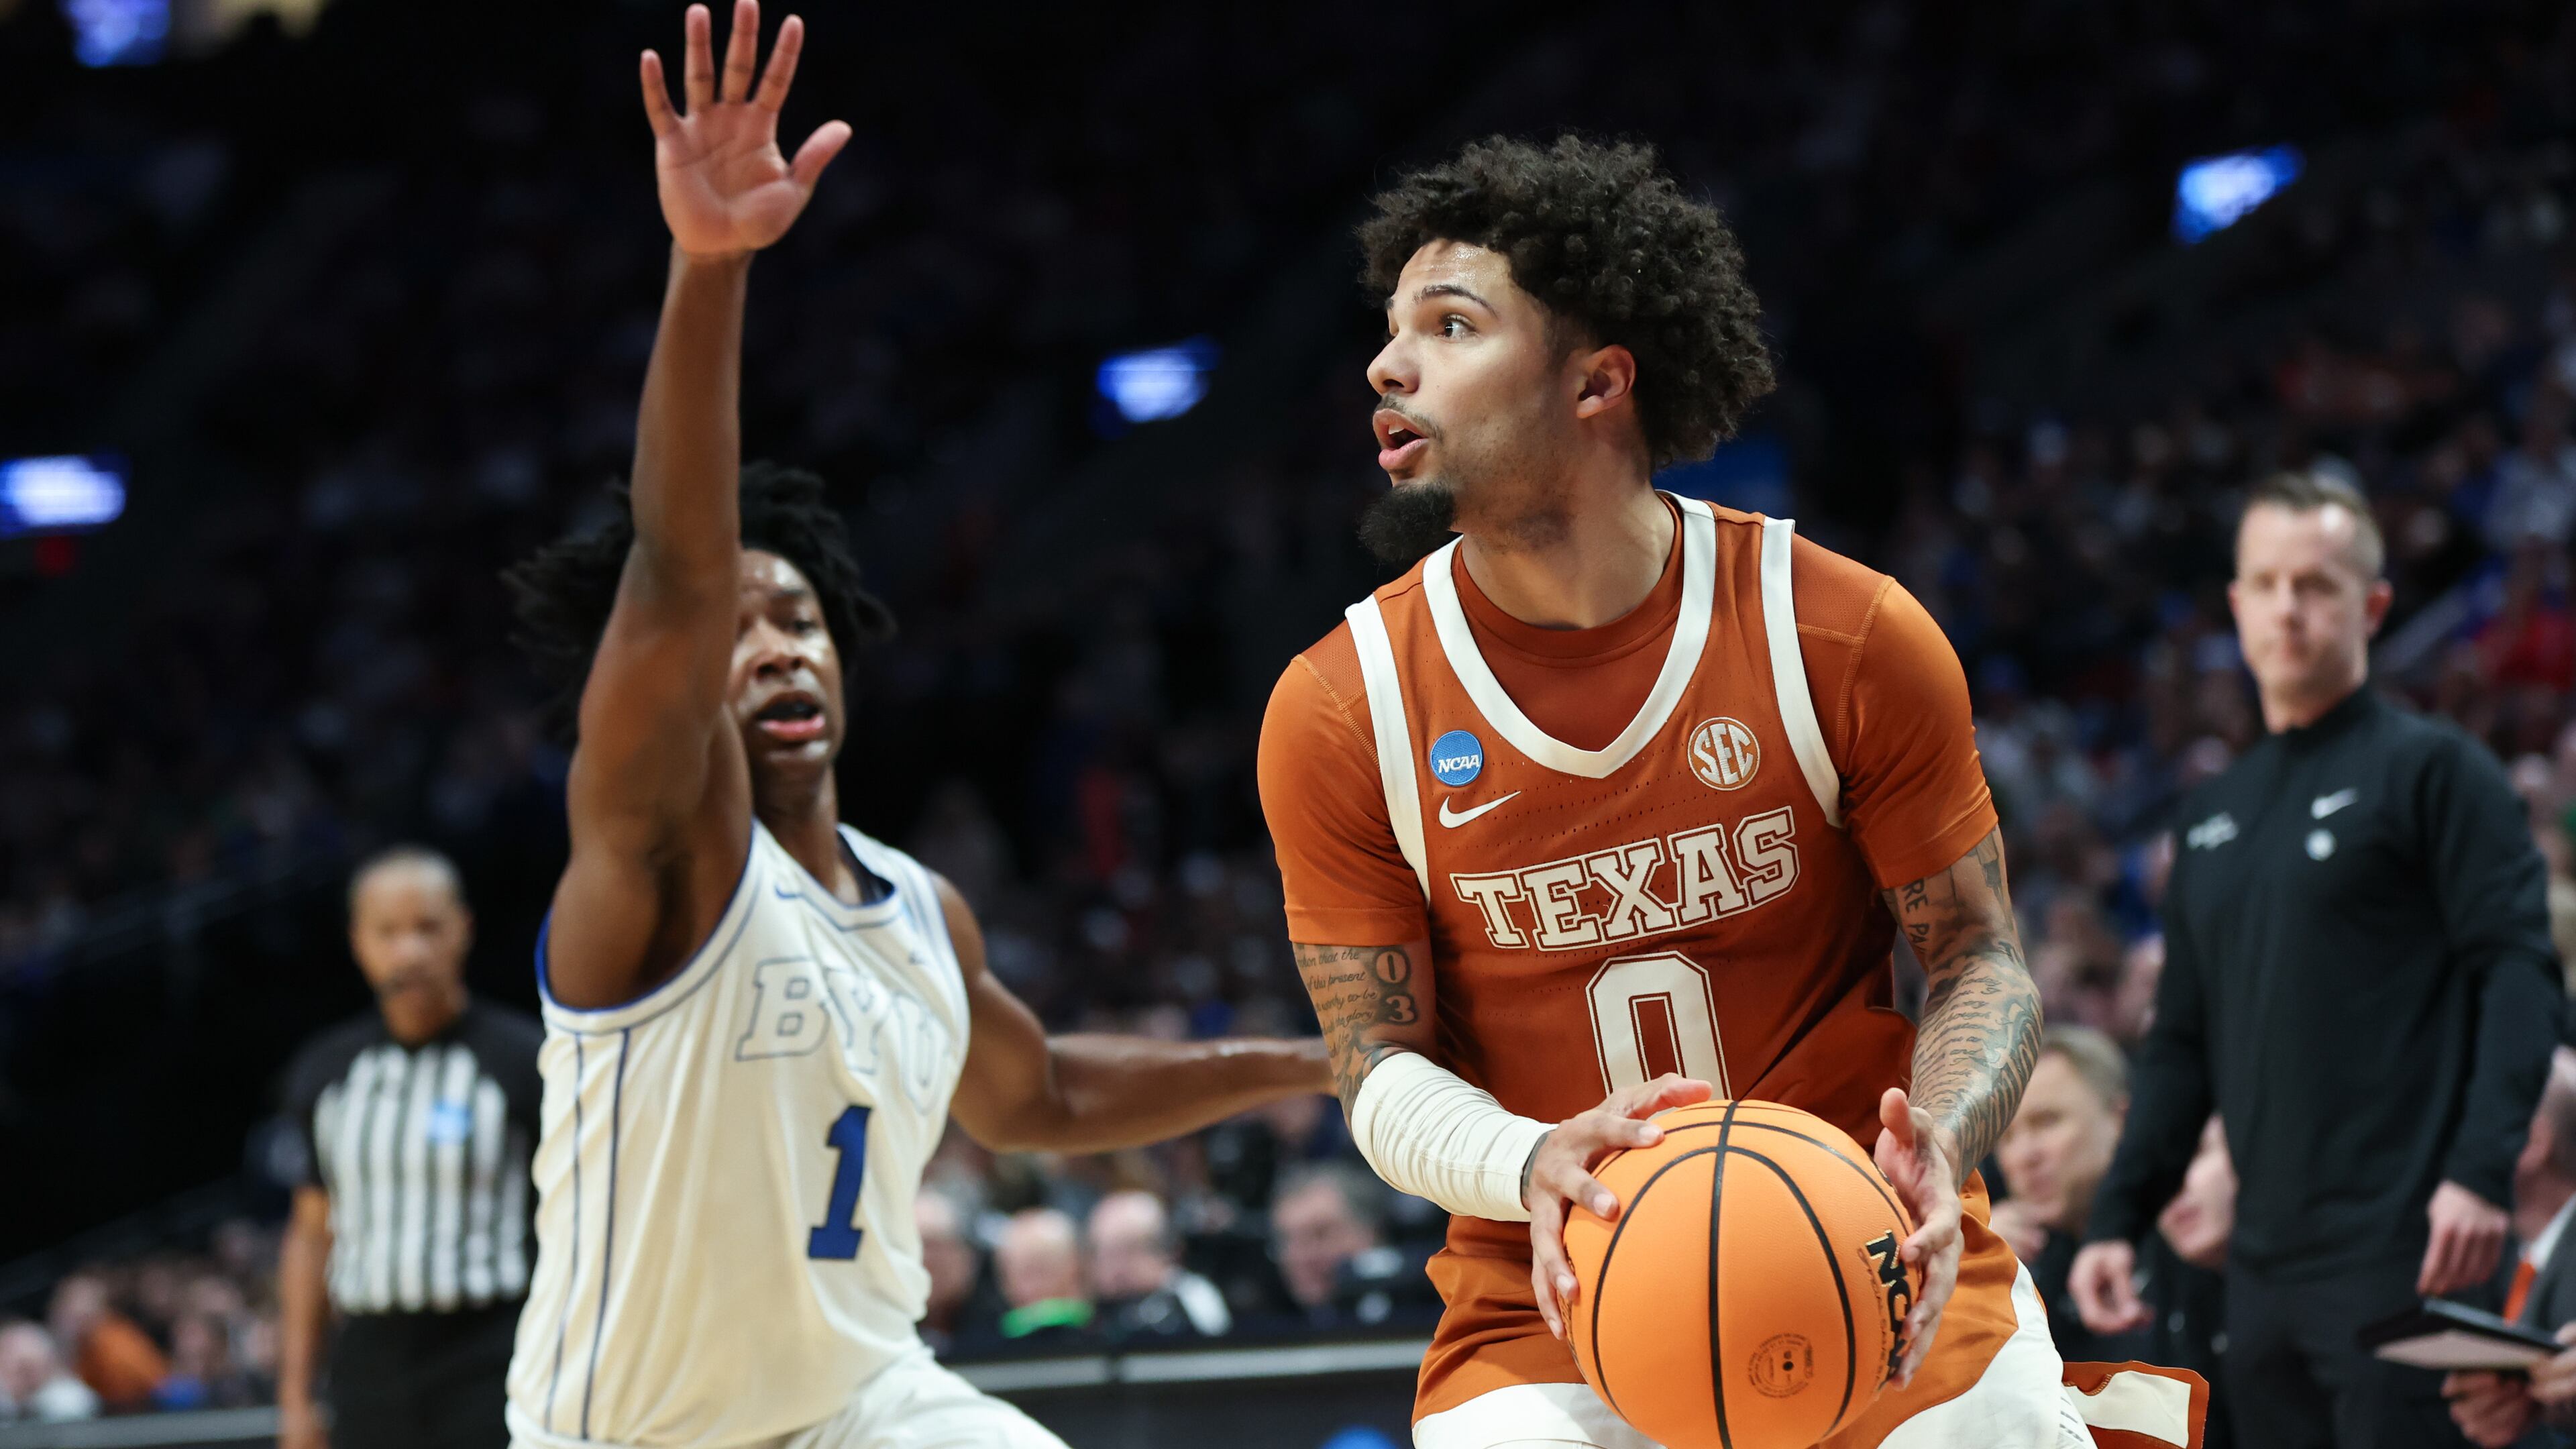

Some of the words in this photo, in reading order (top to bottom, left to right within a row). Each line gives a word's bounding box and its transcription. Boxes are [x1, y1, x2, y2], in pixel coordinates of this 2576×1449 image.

[1438, 754, 1480, 773] NCAA
[1690, 722, 1757, 787] SEC
[1449, 805, 1801, 952] TEXAS
[1341, 947, 1359, 961] the
[735, 956, 953, 1115] BYU
[1585, 951, 1732, 1107] 0
[808, 1104, 872, 1259] 1
[1866, 1229, 1911, 1379] NC
